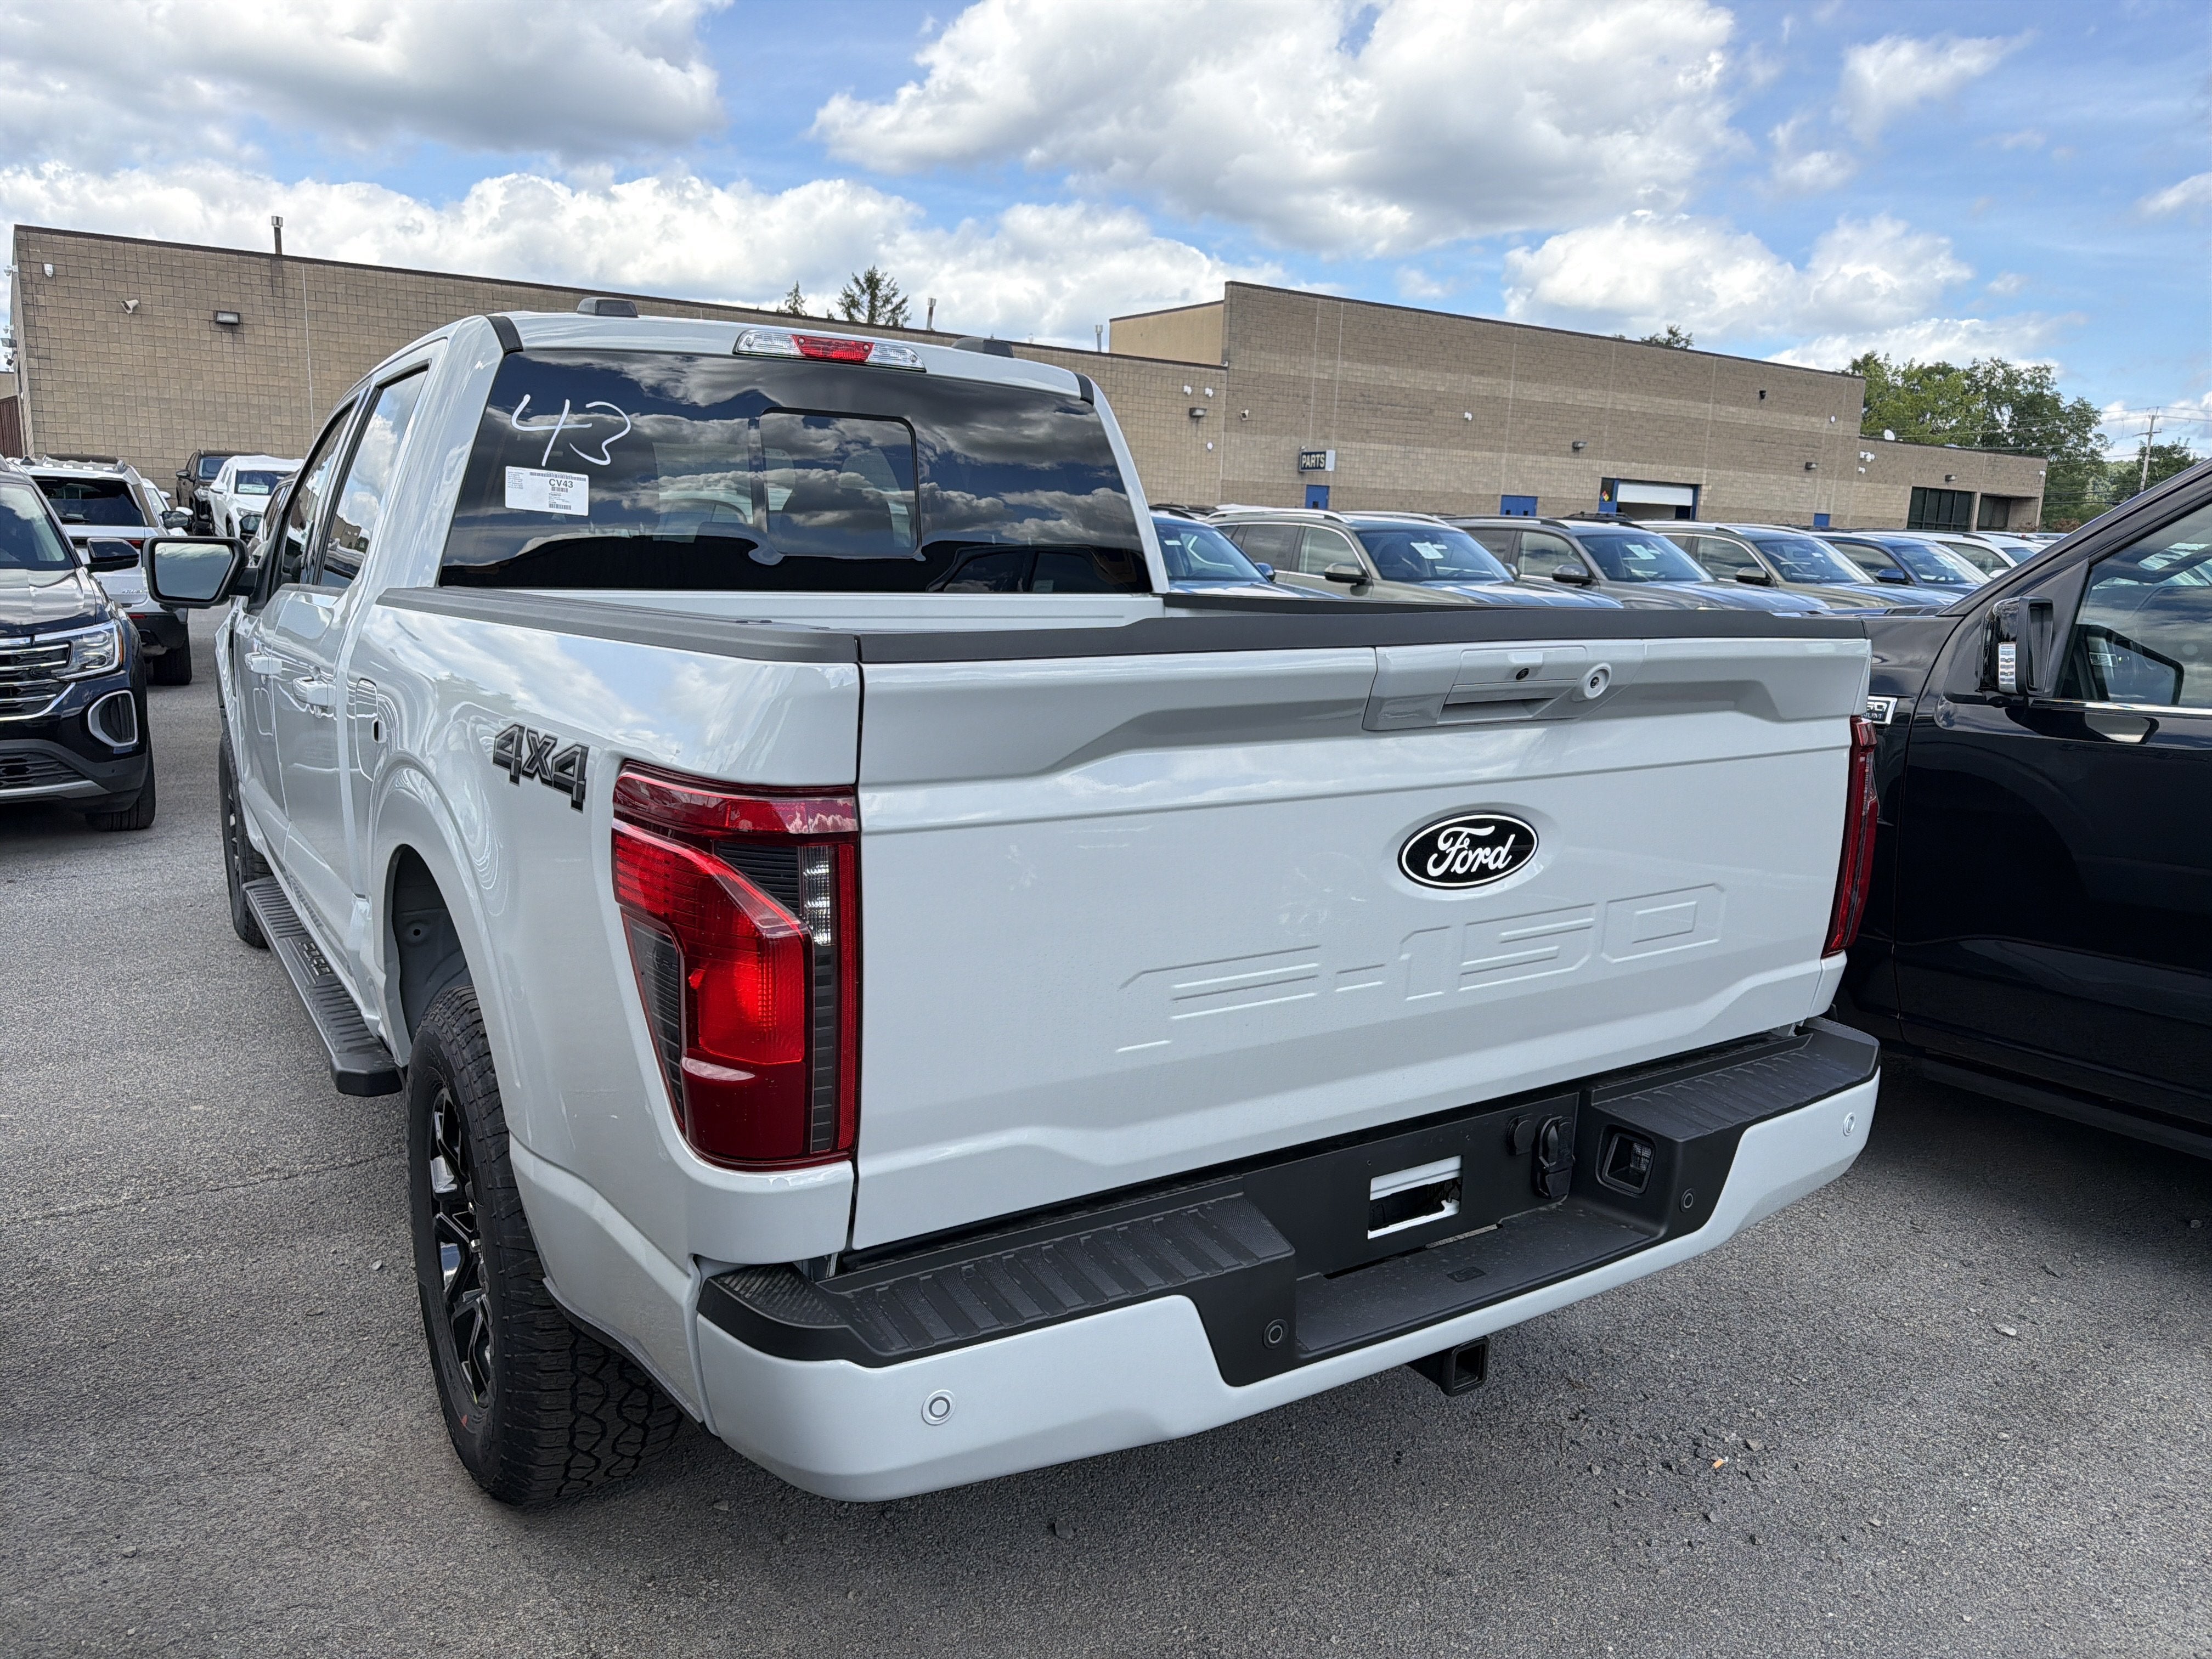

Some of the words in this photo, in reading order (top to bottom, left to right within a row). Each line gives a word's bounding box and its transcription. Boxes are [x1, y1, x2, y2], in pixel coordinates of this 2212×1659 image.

[511, 394, 631, 467] 43
[549, 478, 573, 488] CV43
[1302, 454, 1325, 468] PARTS
[1426, 825, 1516, 877] Ford
[1115, 883, 1726, 1053] F-150
